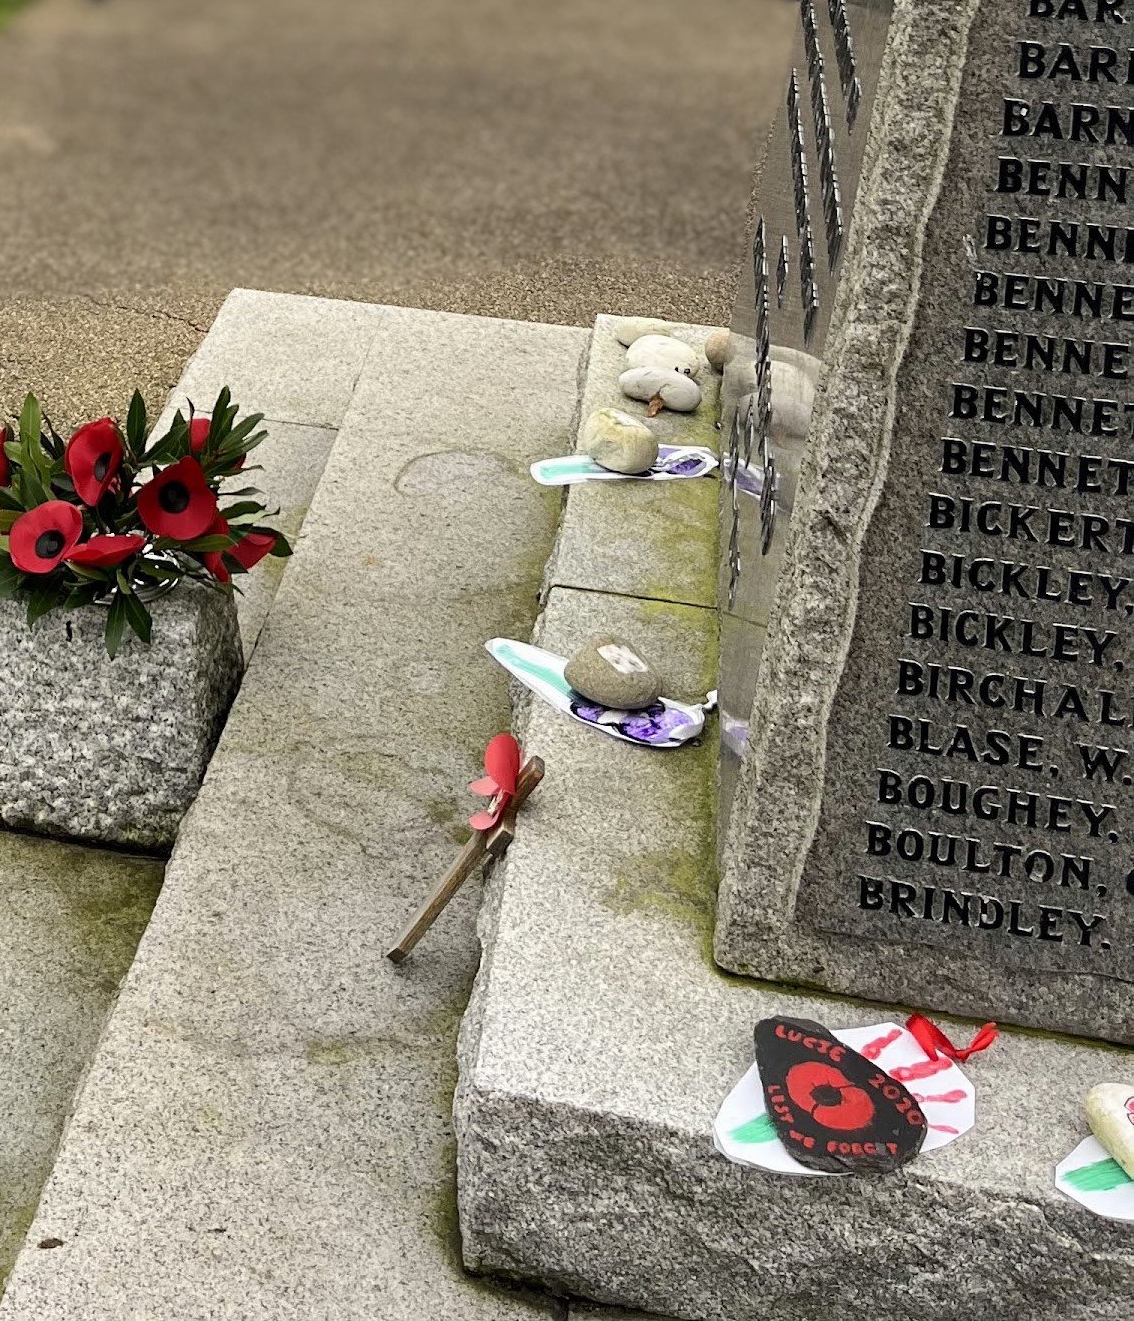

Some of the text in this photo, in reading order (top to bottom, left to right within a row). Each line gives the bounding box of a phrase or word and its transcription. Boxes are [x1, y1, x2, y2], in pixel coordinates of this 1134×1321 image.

[1016, 40, 1134, 85] BAR
[991, 155, 1132, 204] BENN
[960, 326, 1130, 379] BENNE
[938, 437, 1134, 495] BENNET
[917, 549, 1134, 615] BICKLEY,
[906, 602, 1124, 672] BICKLEY,
[894, 658, 1134, 728] BIRCHAL
[886, 714, 1133, 786] BLASE, W.
[868, 1073, 925, 1126] 2020
